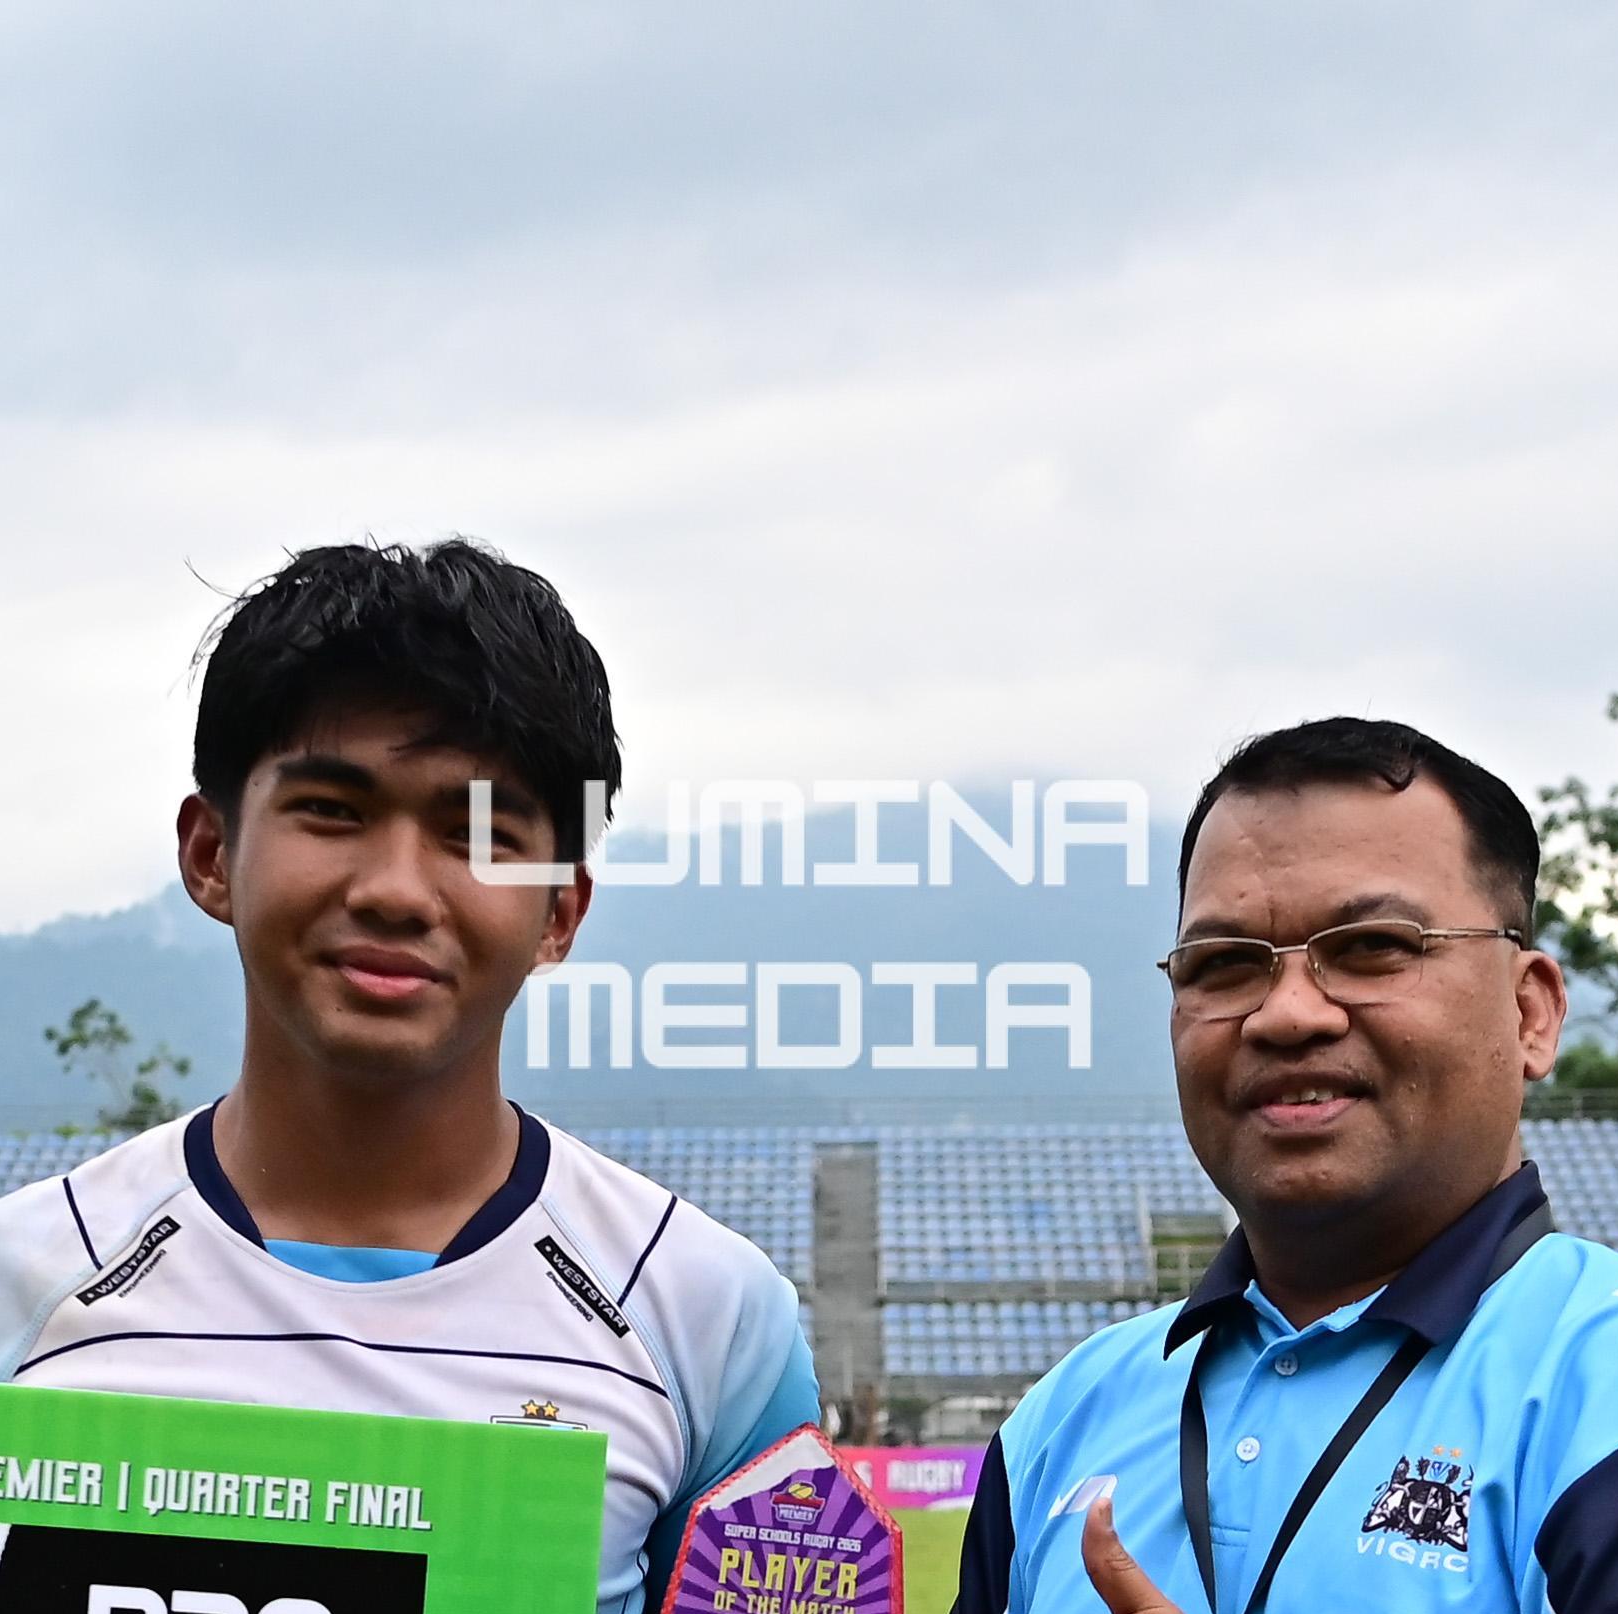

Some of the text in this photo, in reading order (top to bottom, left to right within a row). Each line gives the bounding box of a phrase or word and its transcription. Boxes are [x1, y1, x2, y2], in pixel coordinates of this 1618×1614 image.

[552, 1253, 626, 1329] WESTSTAR
[144, 1466, 311, 1521] QUARTER
[325, 1480, 432, 1530] FINAL
[724, 1523, 757, 1540] SUPER
[758, 1527, 801, 1545] SCHOOLS
[718, 1547, 859, 1600] PLAYER
[713, 1590, 737, 1611] OF
